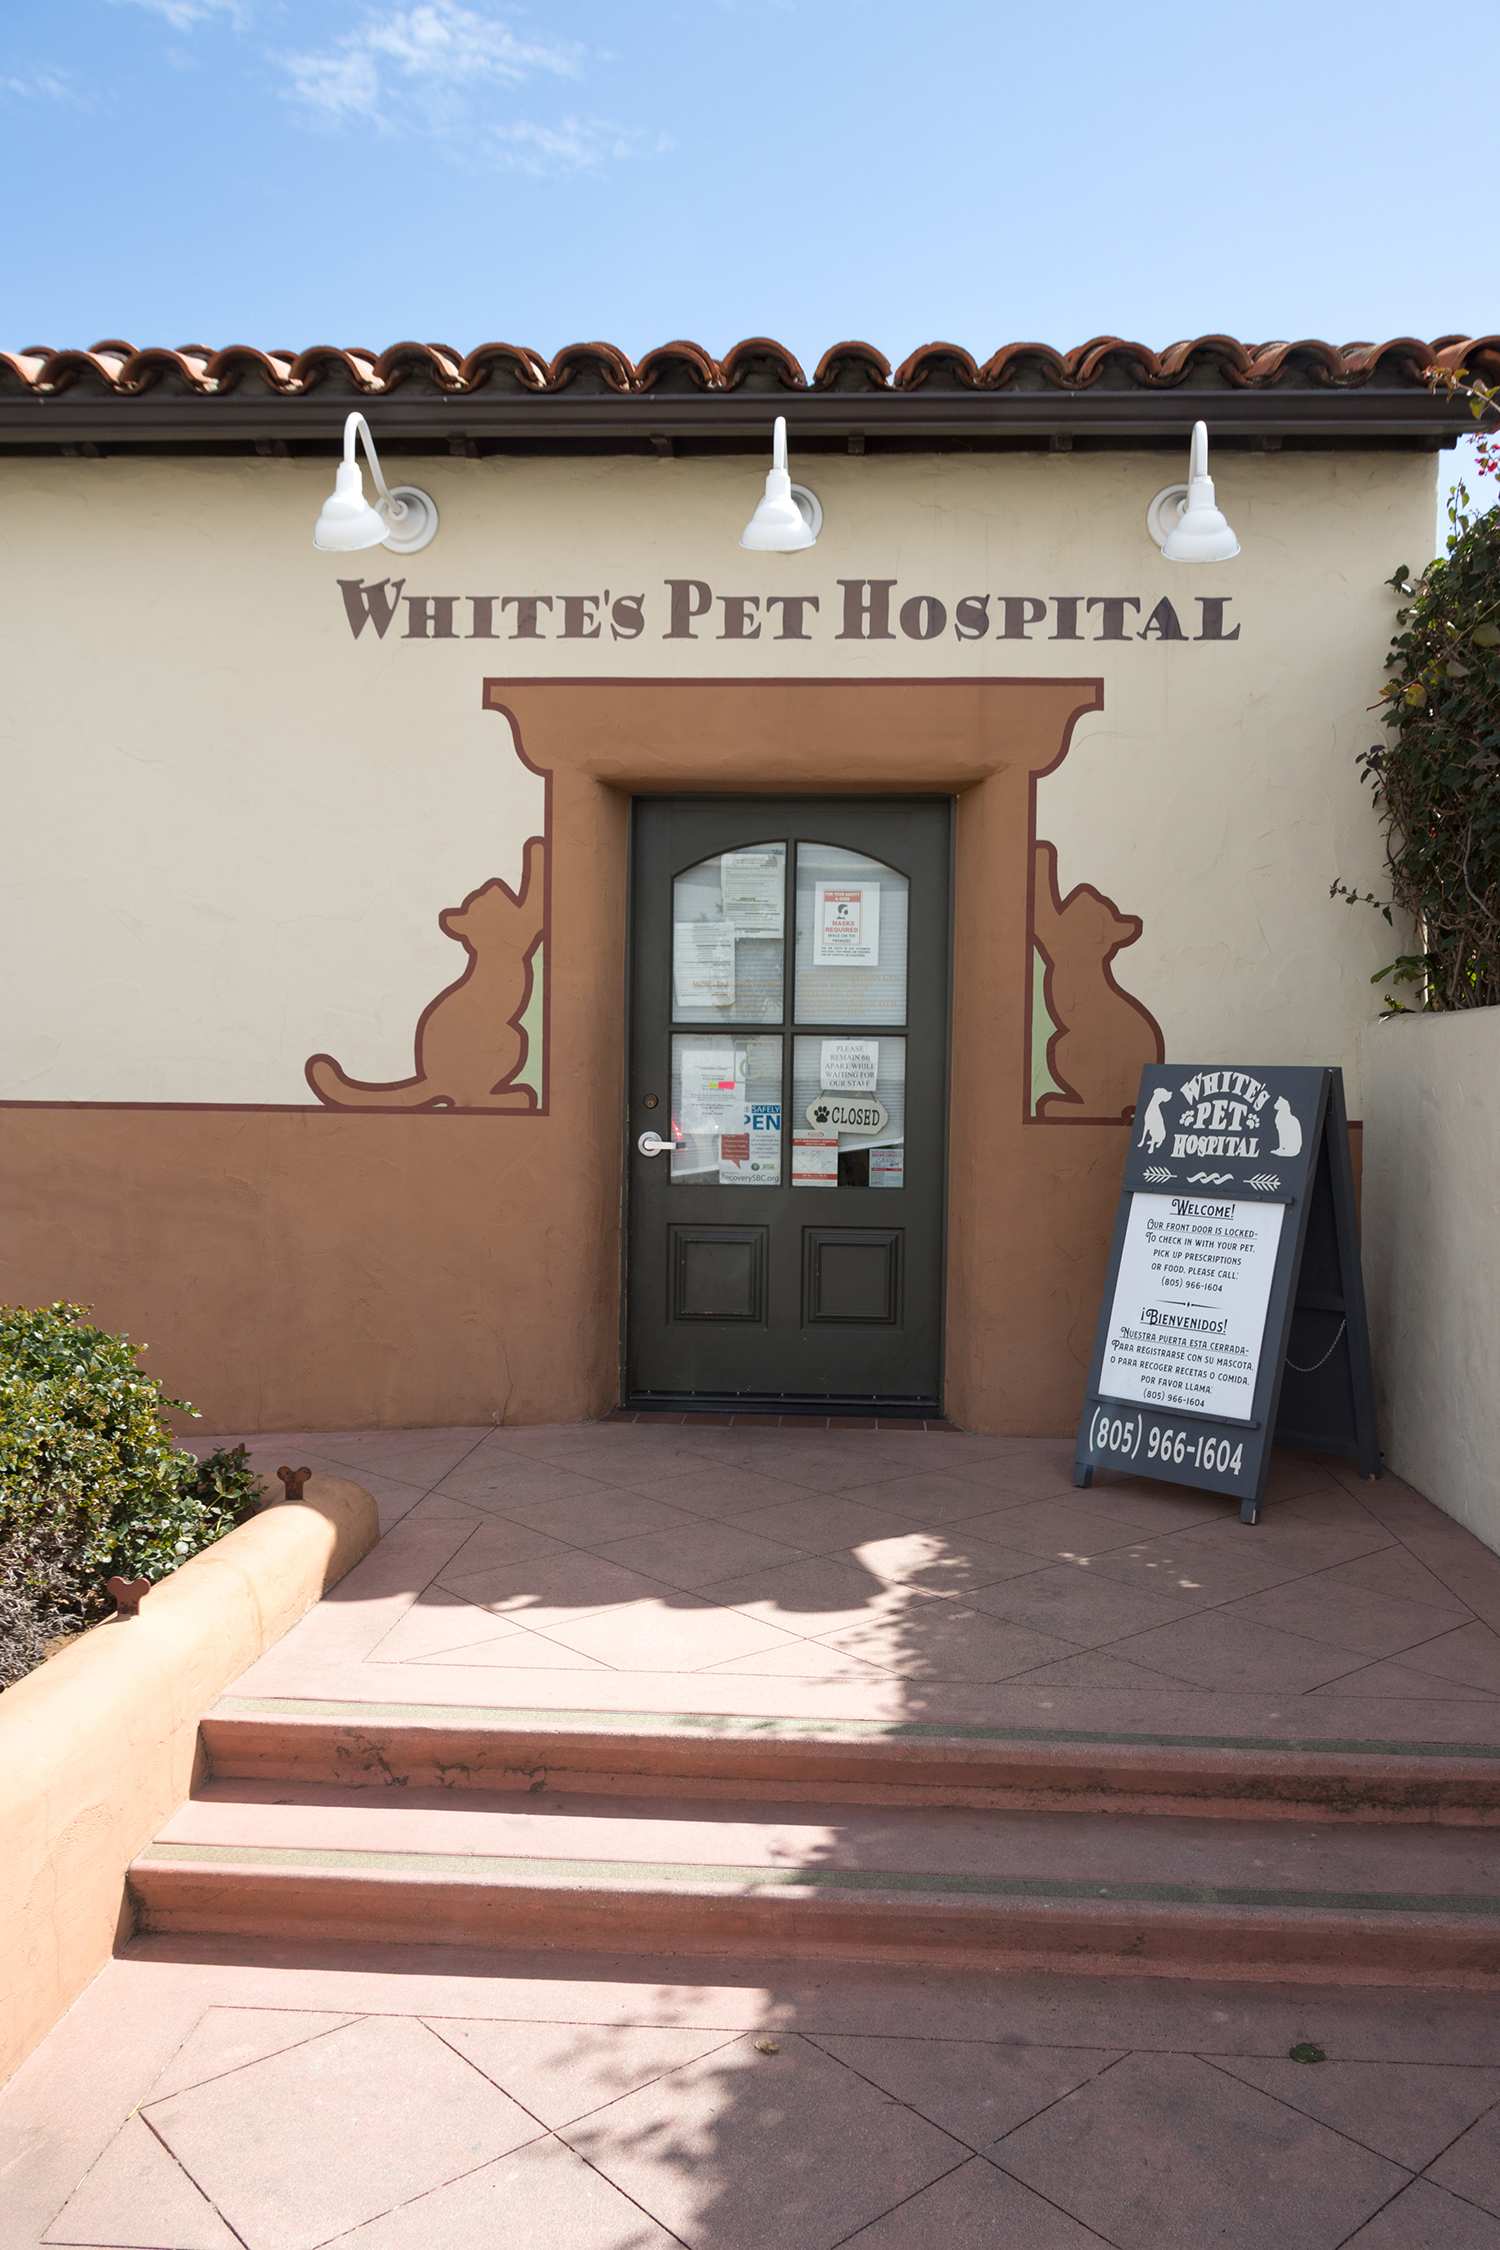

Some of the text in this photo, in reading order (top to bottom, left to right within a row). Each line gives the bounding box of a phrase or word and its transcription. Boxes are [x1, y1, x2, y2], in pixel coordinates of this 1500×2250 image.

[336, 577, 1241, 642] WHITE'S PET HOSPITAL
[1180, 1071, 1271, 1111] WHITE'S
[752, 1105, 781, 1114] SAFELY
[831, 1106, 880, 1127] CLOSED
[1193, 1100, 1248, 1131] PET
[1170, 1134, 1260, 1158] HOSPITAL
[1172, 1198, 1235, 1219] WELCOME!
[1147, 1218, 1164, 1230] OUR
[1166, 1222, 1189, 1232] FRONT
[1192, 1224, 1213, 1234] DOOR
[1214, 1226, 1222, 1234] IS
[1145, 1232, 1157, 1244] TO
[1158, 1236, 1182, 1246] CHECK
[1184, 1238, 1192, 1246] IN
[1195, 1239, 1215, 1249] WITH
[1217, 1241, 1237, 1251] YOUR
[1153, 1249, 1242, 1266] PICK UP PRESCRIPTIONS
[1151, 1262, 1161, 1271] OR
[1188, 1267, 1215, 1277] PLEASE
[1161, 1276, 1223, 1292] (805) 966-1604
[1120, 1326, 1157, 1341] NUESTRA
[1158, 1334, 1187, 1346] PUERTA
[1190, 1338, 1208, 1349] ESTA
[1111, 1339, 1134, 1352] PARA
[1136, 1345, 1185, 1360] REGISTRARSE
[1187, 1353, 1202, 1362] CON
[1204, 1356, 1214, 1365] SU
[1110, 1356, 1116, 1364] O
[1118, 1357, 1138, 1367] PARA
[1140, 1361, 1173, 1373] RECOGER
[1176, 1366, 1208, 1379] RECETAS
[1210, 1372, 1215, 1380] O
[1141, 1375, 1156, 1384] POR
[1158, 1378, 1183, 1389] FAVOR
[1144, 1388, 1205, 1408] (805) 966-1604
[1089, 1406, 1244, 1476] (805) 966-1604
